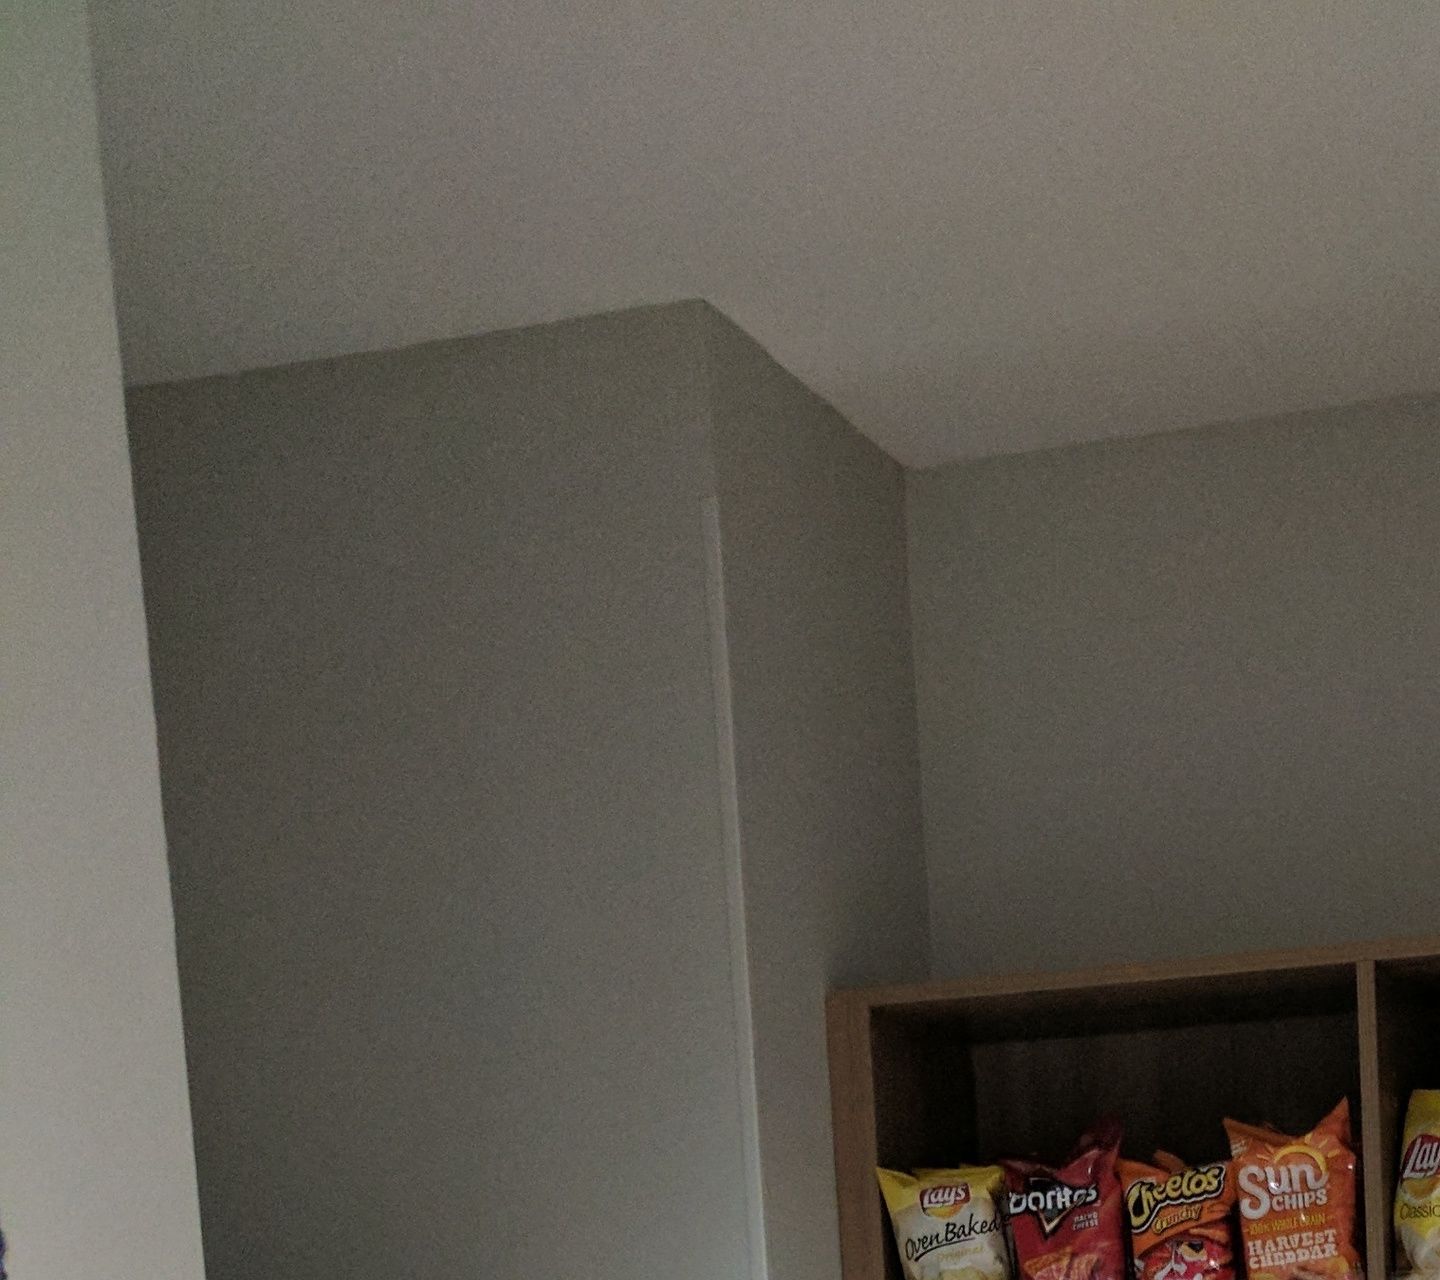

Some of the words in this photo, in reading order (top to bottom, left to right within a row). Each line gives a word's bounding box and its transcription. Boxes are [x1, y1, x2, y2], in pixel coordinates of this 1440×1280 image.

[1009, 1184, 1098, 1215] Doritos
[1126, 1165, 1225, 1228] Cheetos
[1238, 1164, 1329, 1220] Sun
[1271, 1188, 1328, 1212] CHIPS
[905, 1230, 944, 1261] Oven
[945, 1212, 1001, 1243] Baked
[1247, 1229, 1338, 1256] HARVEST
[1249, 1245, 1339, 1269] CHEDDAR
